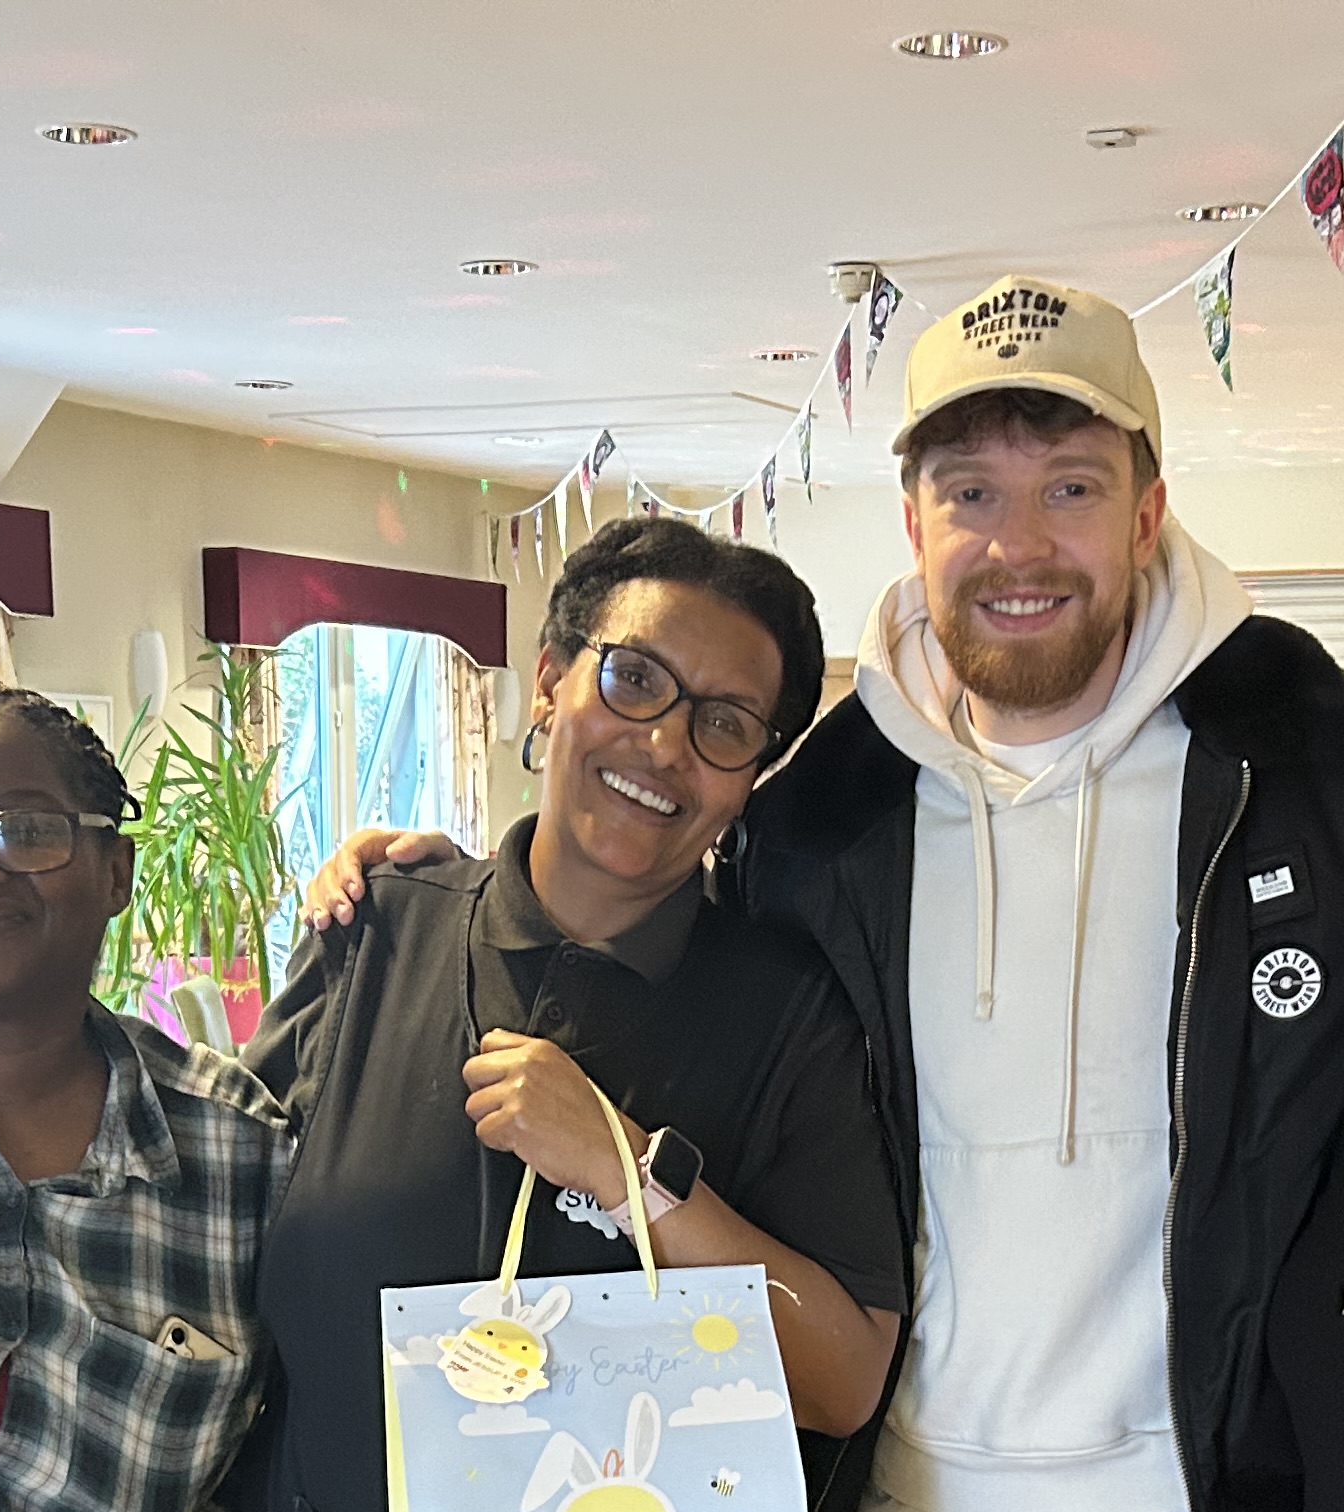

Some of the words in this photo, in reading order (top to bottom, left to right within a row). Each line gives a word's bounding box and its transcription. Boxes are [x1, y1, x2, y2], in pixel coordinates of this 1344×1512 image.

[962, 288, 1067, 330] BRIXTON
[964, 313, 1015, 341] STREET
[1019, 312, 1059, 328] WEAR
[1257, 951, 1316, 978] BRIXTON
[1256, 987, 1288, 1014] STREET
[1290, 986, 1316, 1012] WEAR
[590, 1345, 690, 1387] Easter
